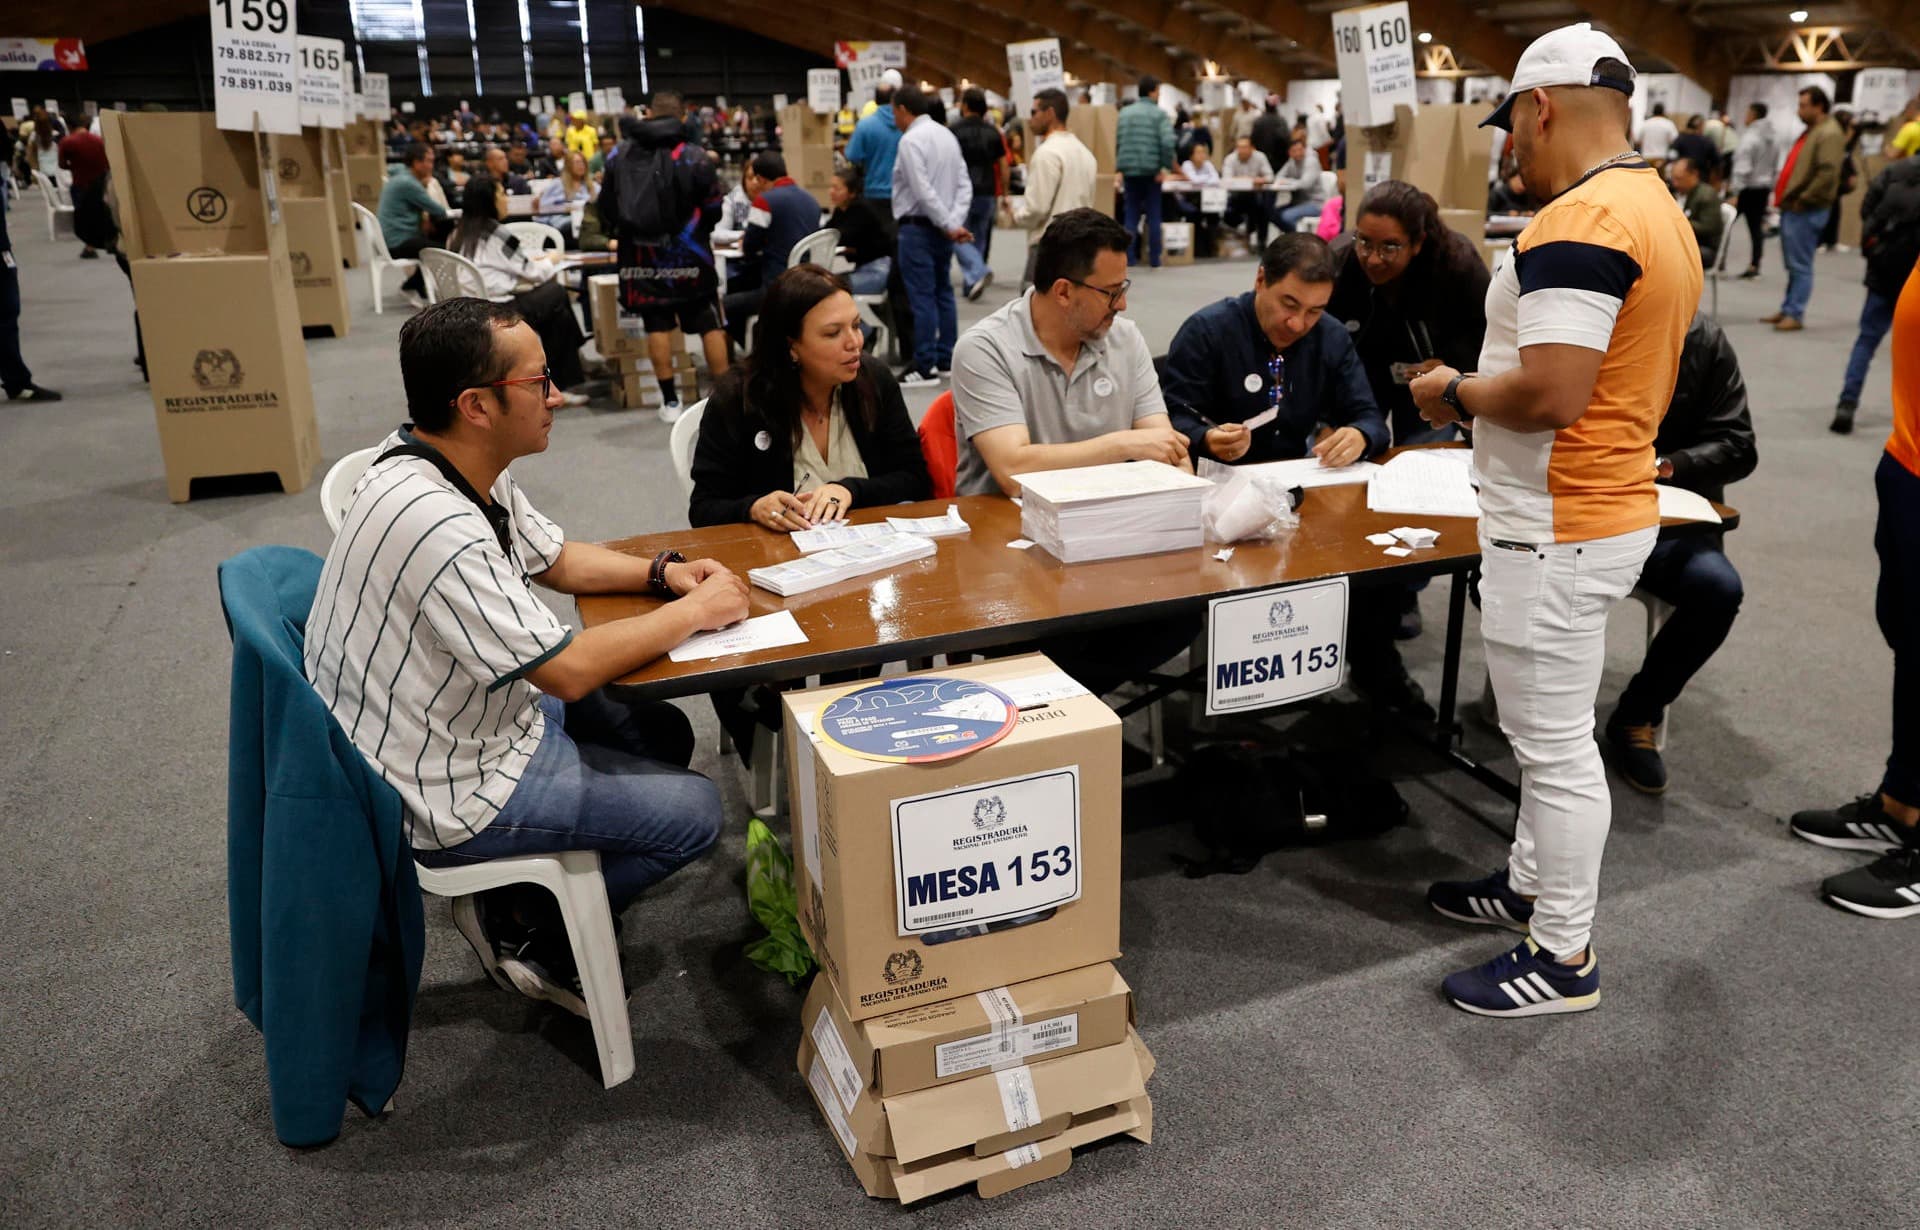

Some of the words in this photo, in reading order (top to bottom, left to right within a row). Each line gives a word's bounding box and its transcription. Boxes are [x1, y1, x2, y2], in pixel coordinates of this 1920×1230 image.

[216, 0, 288, 33] 159
[1336, 26, 1360, 53] 160
[1366, 17, 1406, 50] 160
[218, 46, 291, 64] 79.882.577
[300, 46, 340, 70] 165
[1030, 51, 1059, 70] 166
[219, 75, 293, 93] 79.891.039
[165, 390, 278, 407] REGISTRADURÍA
[1216, 653, 1285, 690] MESA
[1291, 643, 1339, 676] 153
[952, 824, 1028, 847] REGISTRADURÍA
[907, 861, 1000, 907] MESA
[1008, 845, 1073, 886] 153
[860, 976, 948, 1003] REGISTRADURÍA
[860, 997, 891, 1008] NACIONAL
